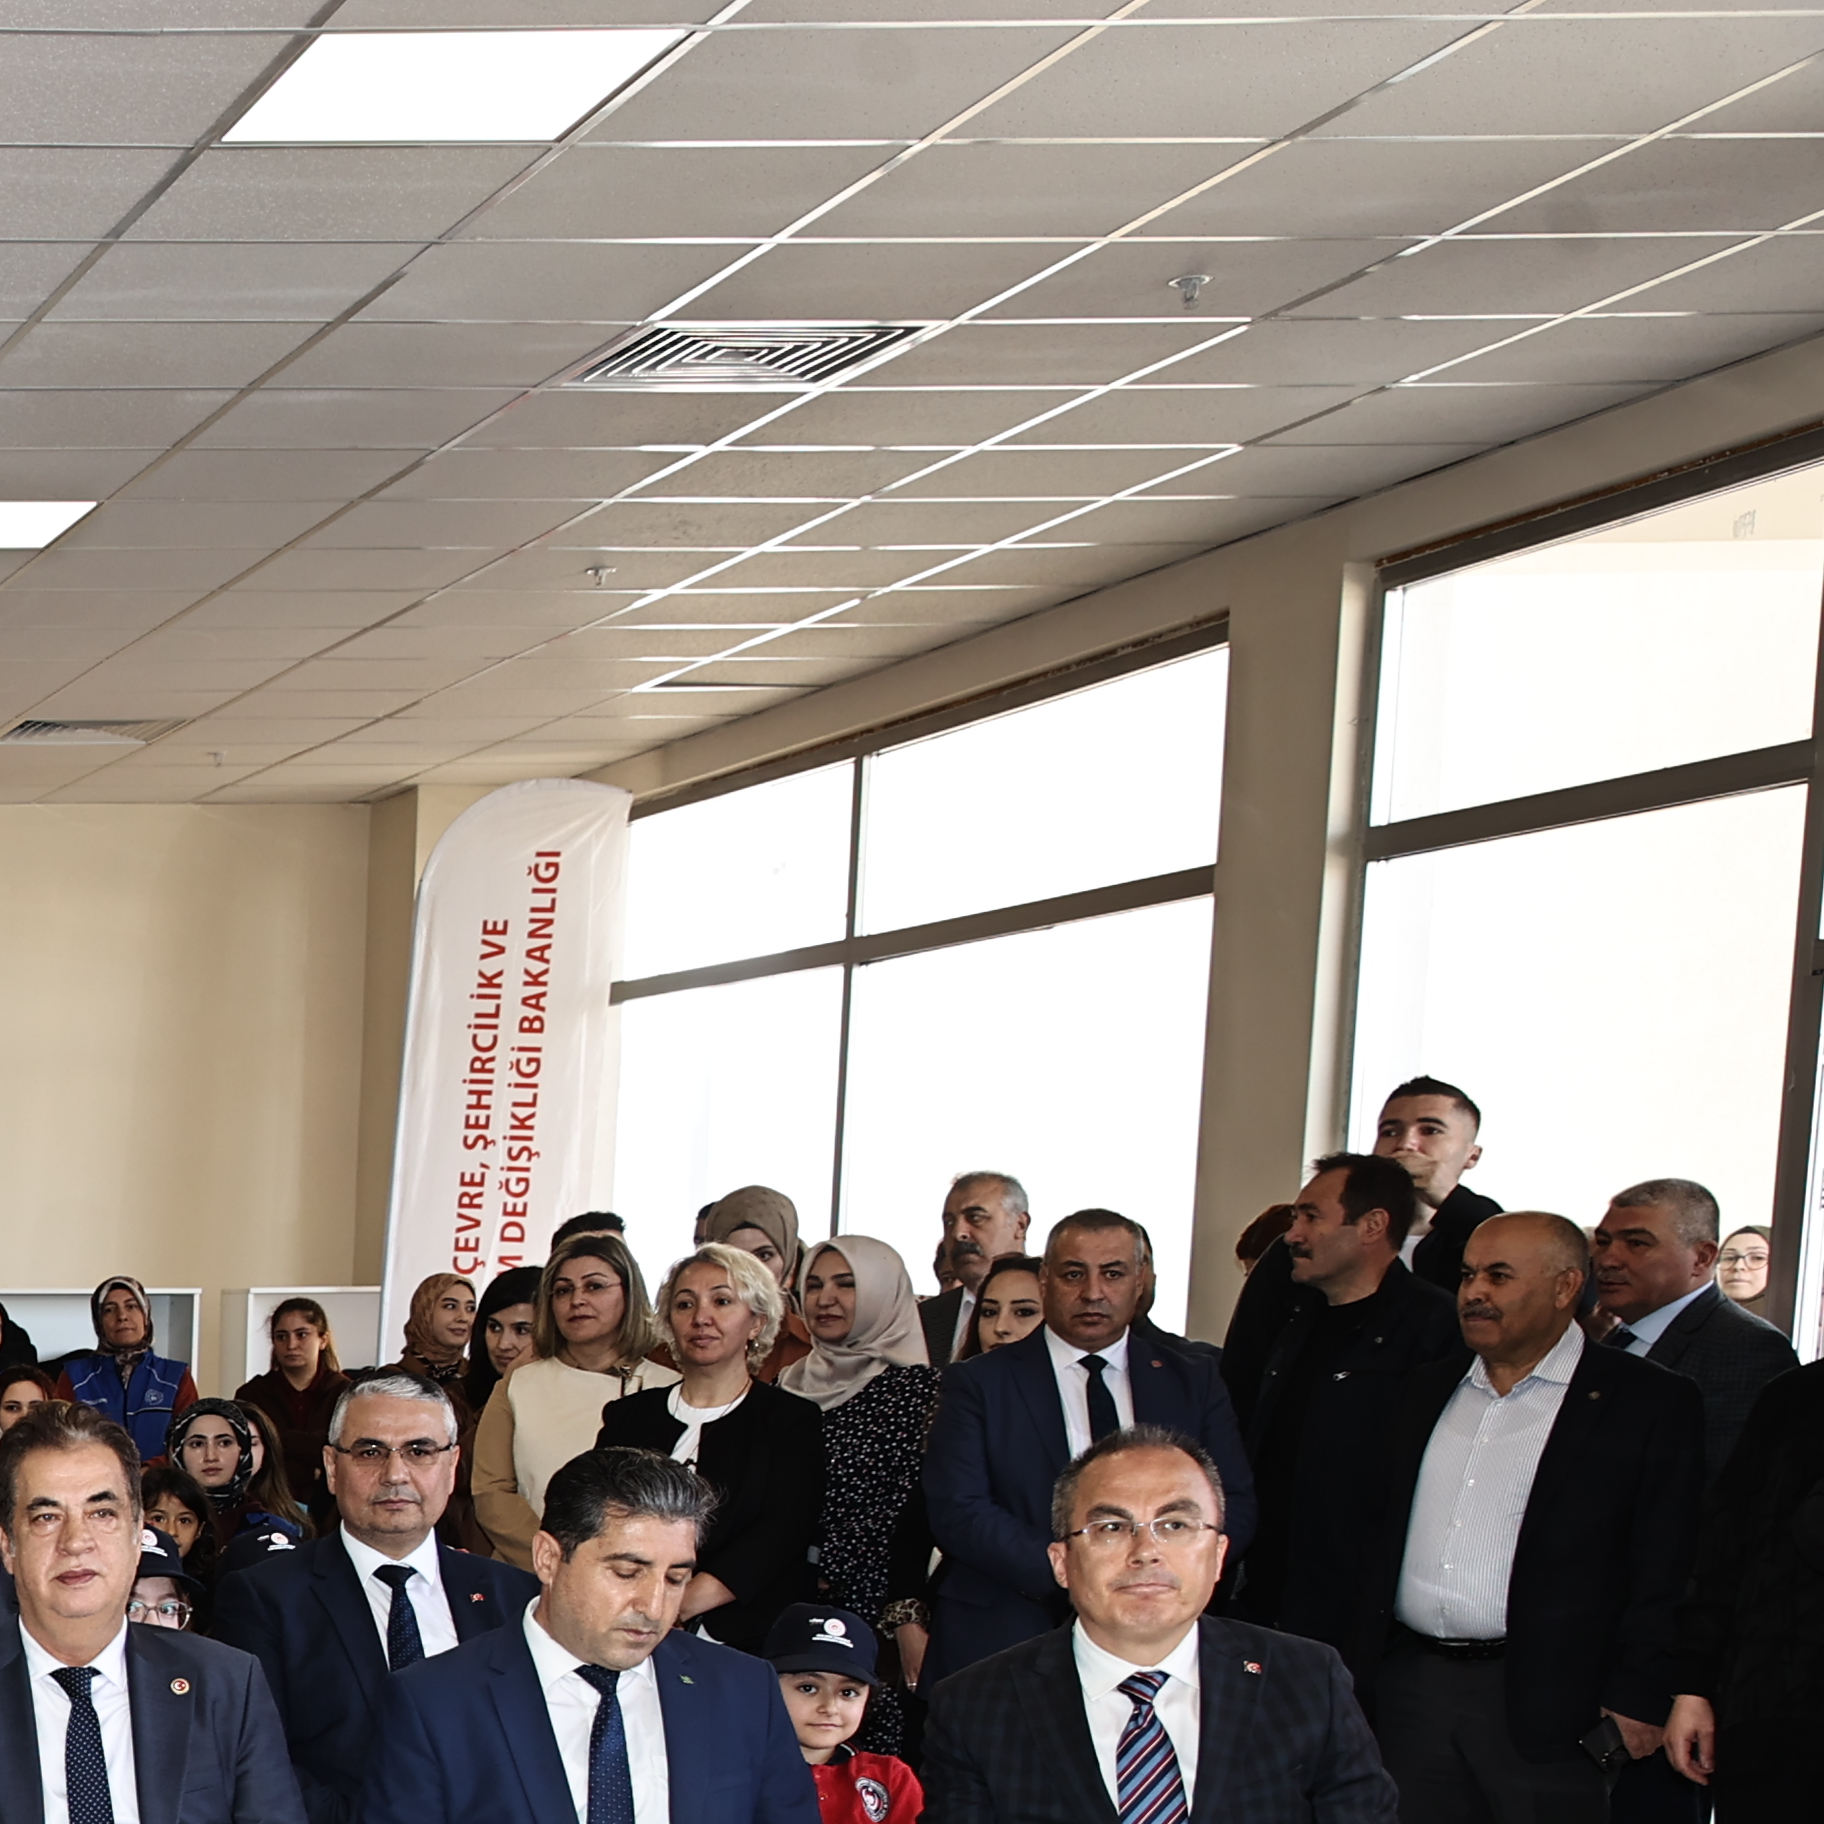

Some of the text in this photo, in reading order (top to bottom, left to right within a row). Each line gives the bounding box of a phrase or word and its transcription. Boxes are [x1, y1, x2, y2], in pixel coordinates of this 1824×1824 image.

[518, 851, 562, 1034] BAKANLIĞI
[452, 919, 509, 1275] ÇEVRE, ŞEHİRCİLİK VE
[497, 1046, 543, 1243] DEĞİŞİKLİĞİ
